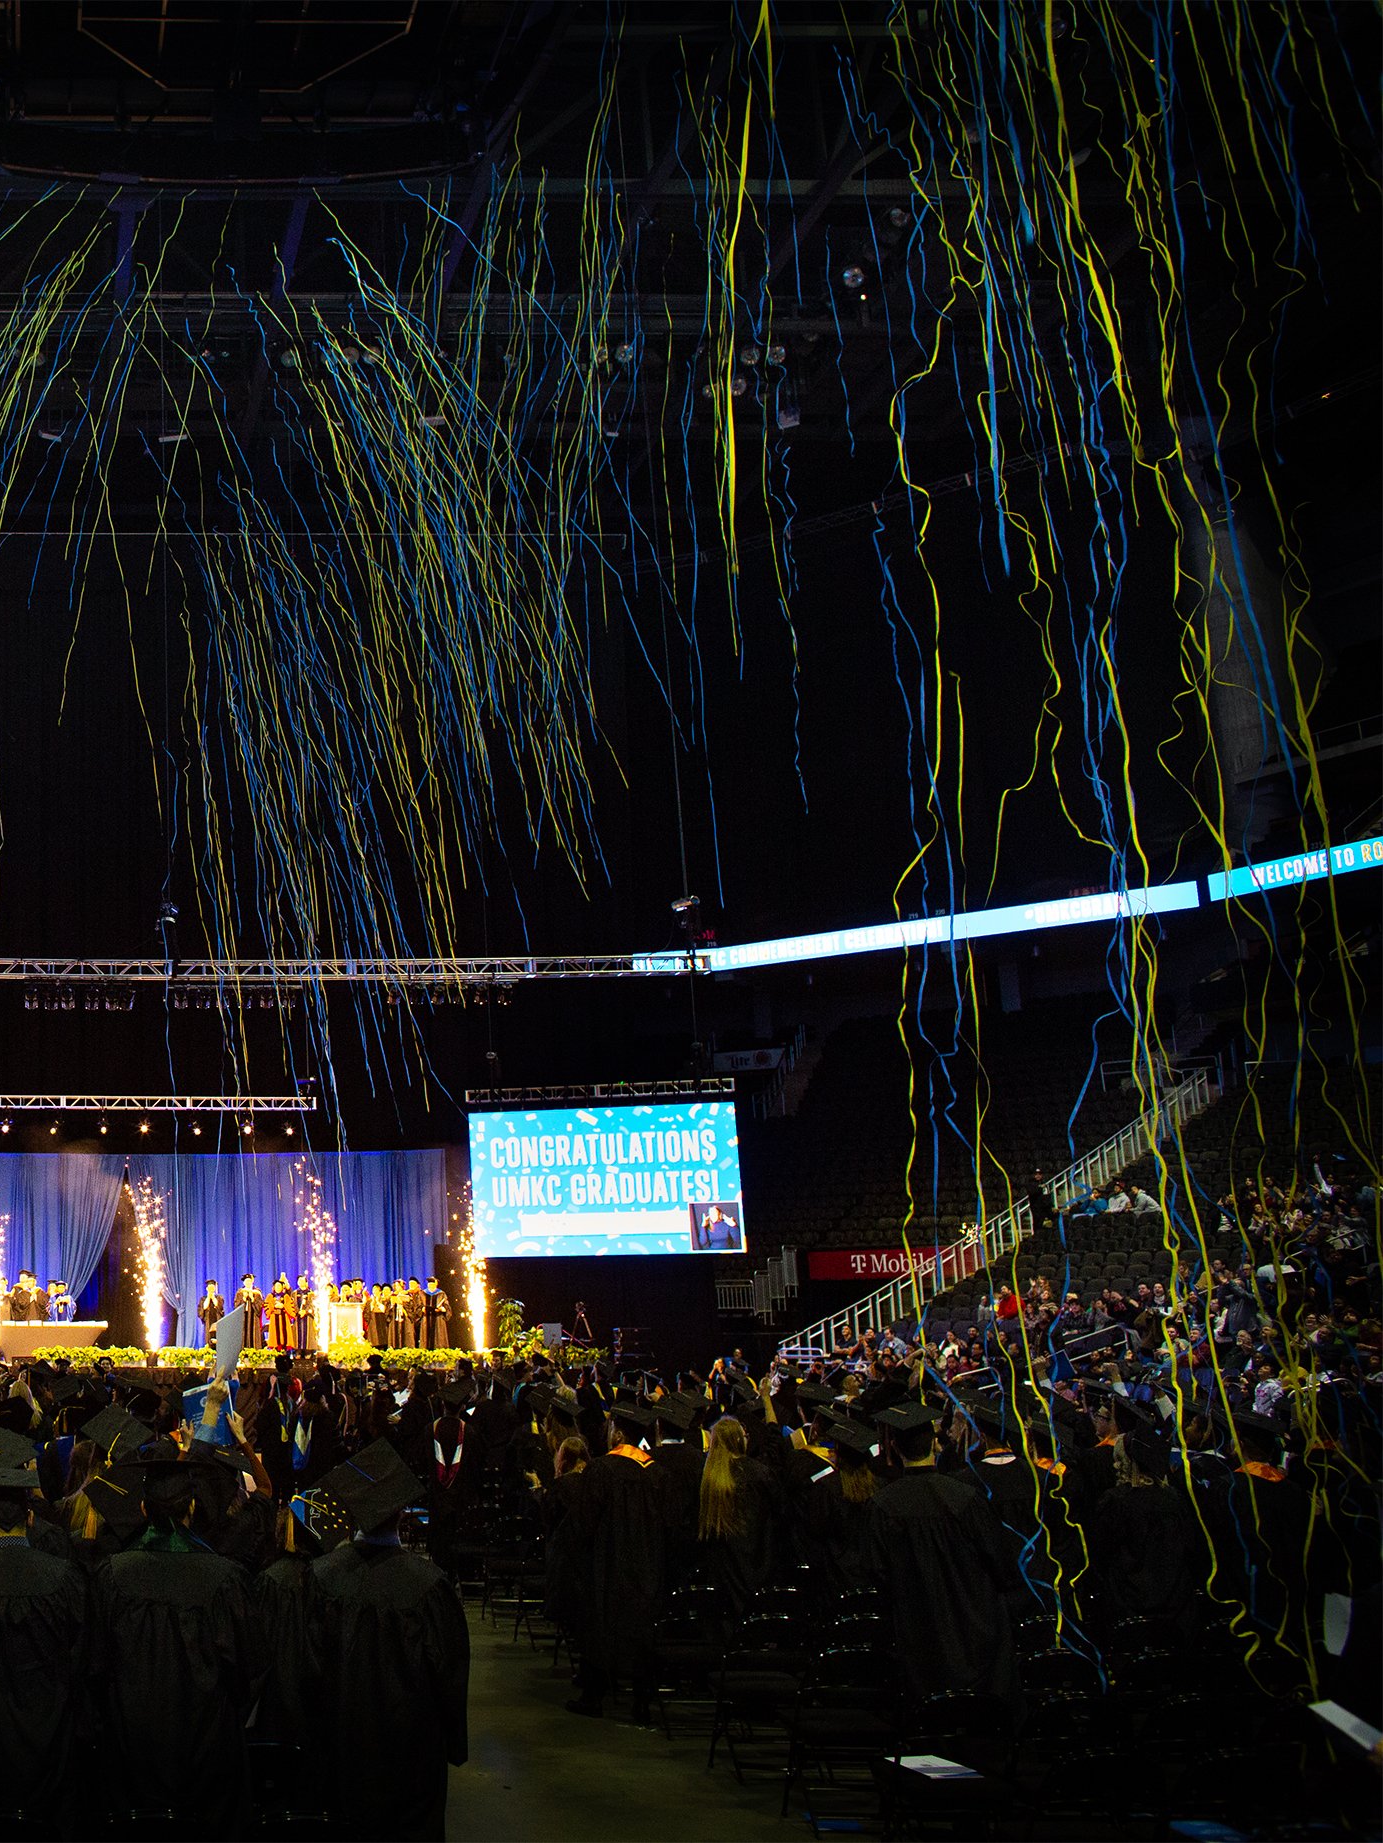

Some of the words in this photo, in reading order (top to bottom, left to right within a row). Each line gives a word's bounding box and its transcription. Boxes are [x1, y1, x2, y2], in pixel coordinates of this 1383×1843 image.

[1250, 853, 1329, 886] WELCOME
[1333, 847, 1354, 868] TO
[490, 1128, 717, 1169] CONGRATULATIONS
[492, 1173, 562, 1207] UMKC
[570, 1169, 720, 1206] GRADUATES!
